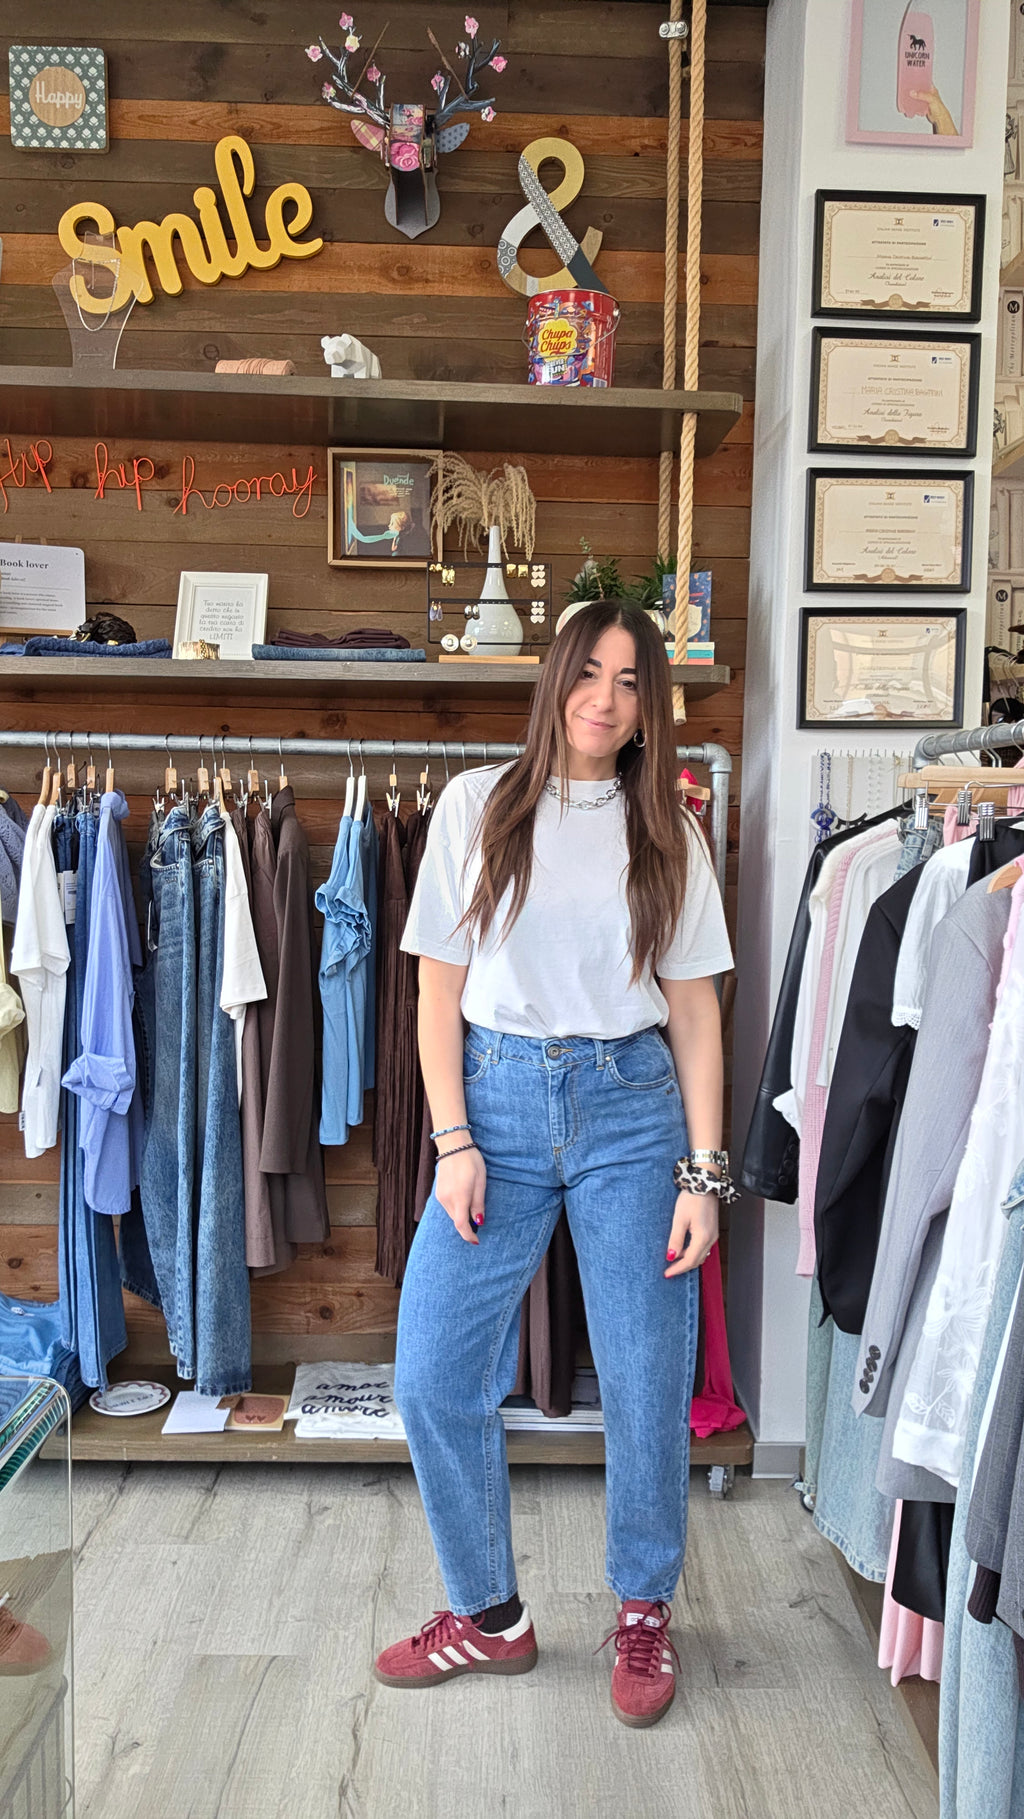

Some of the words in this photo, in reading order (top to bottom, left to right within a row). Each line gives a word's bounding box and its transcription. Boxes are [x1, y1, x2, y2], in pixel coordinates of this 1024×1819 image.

[905, 51, 930, 60] UNICORN
[907, 59, 926, 68] WATER
[35, 81, 84, 109] Happy
[58, 135, 323, 314] Smile
[541, 328, 574, 341] Chupa
[540, 340, 572, 354] Chups
[94, 442, 155, 511] hip
[173, 455, 318, 518] hooray
[383, 472, 415, 486] Duende
[0, 559, 24, 568] Book
[26, 560, 49, 569] lover
[302, 1393, 394, 1405] amour
